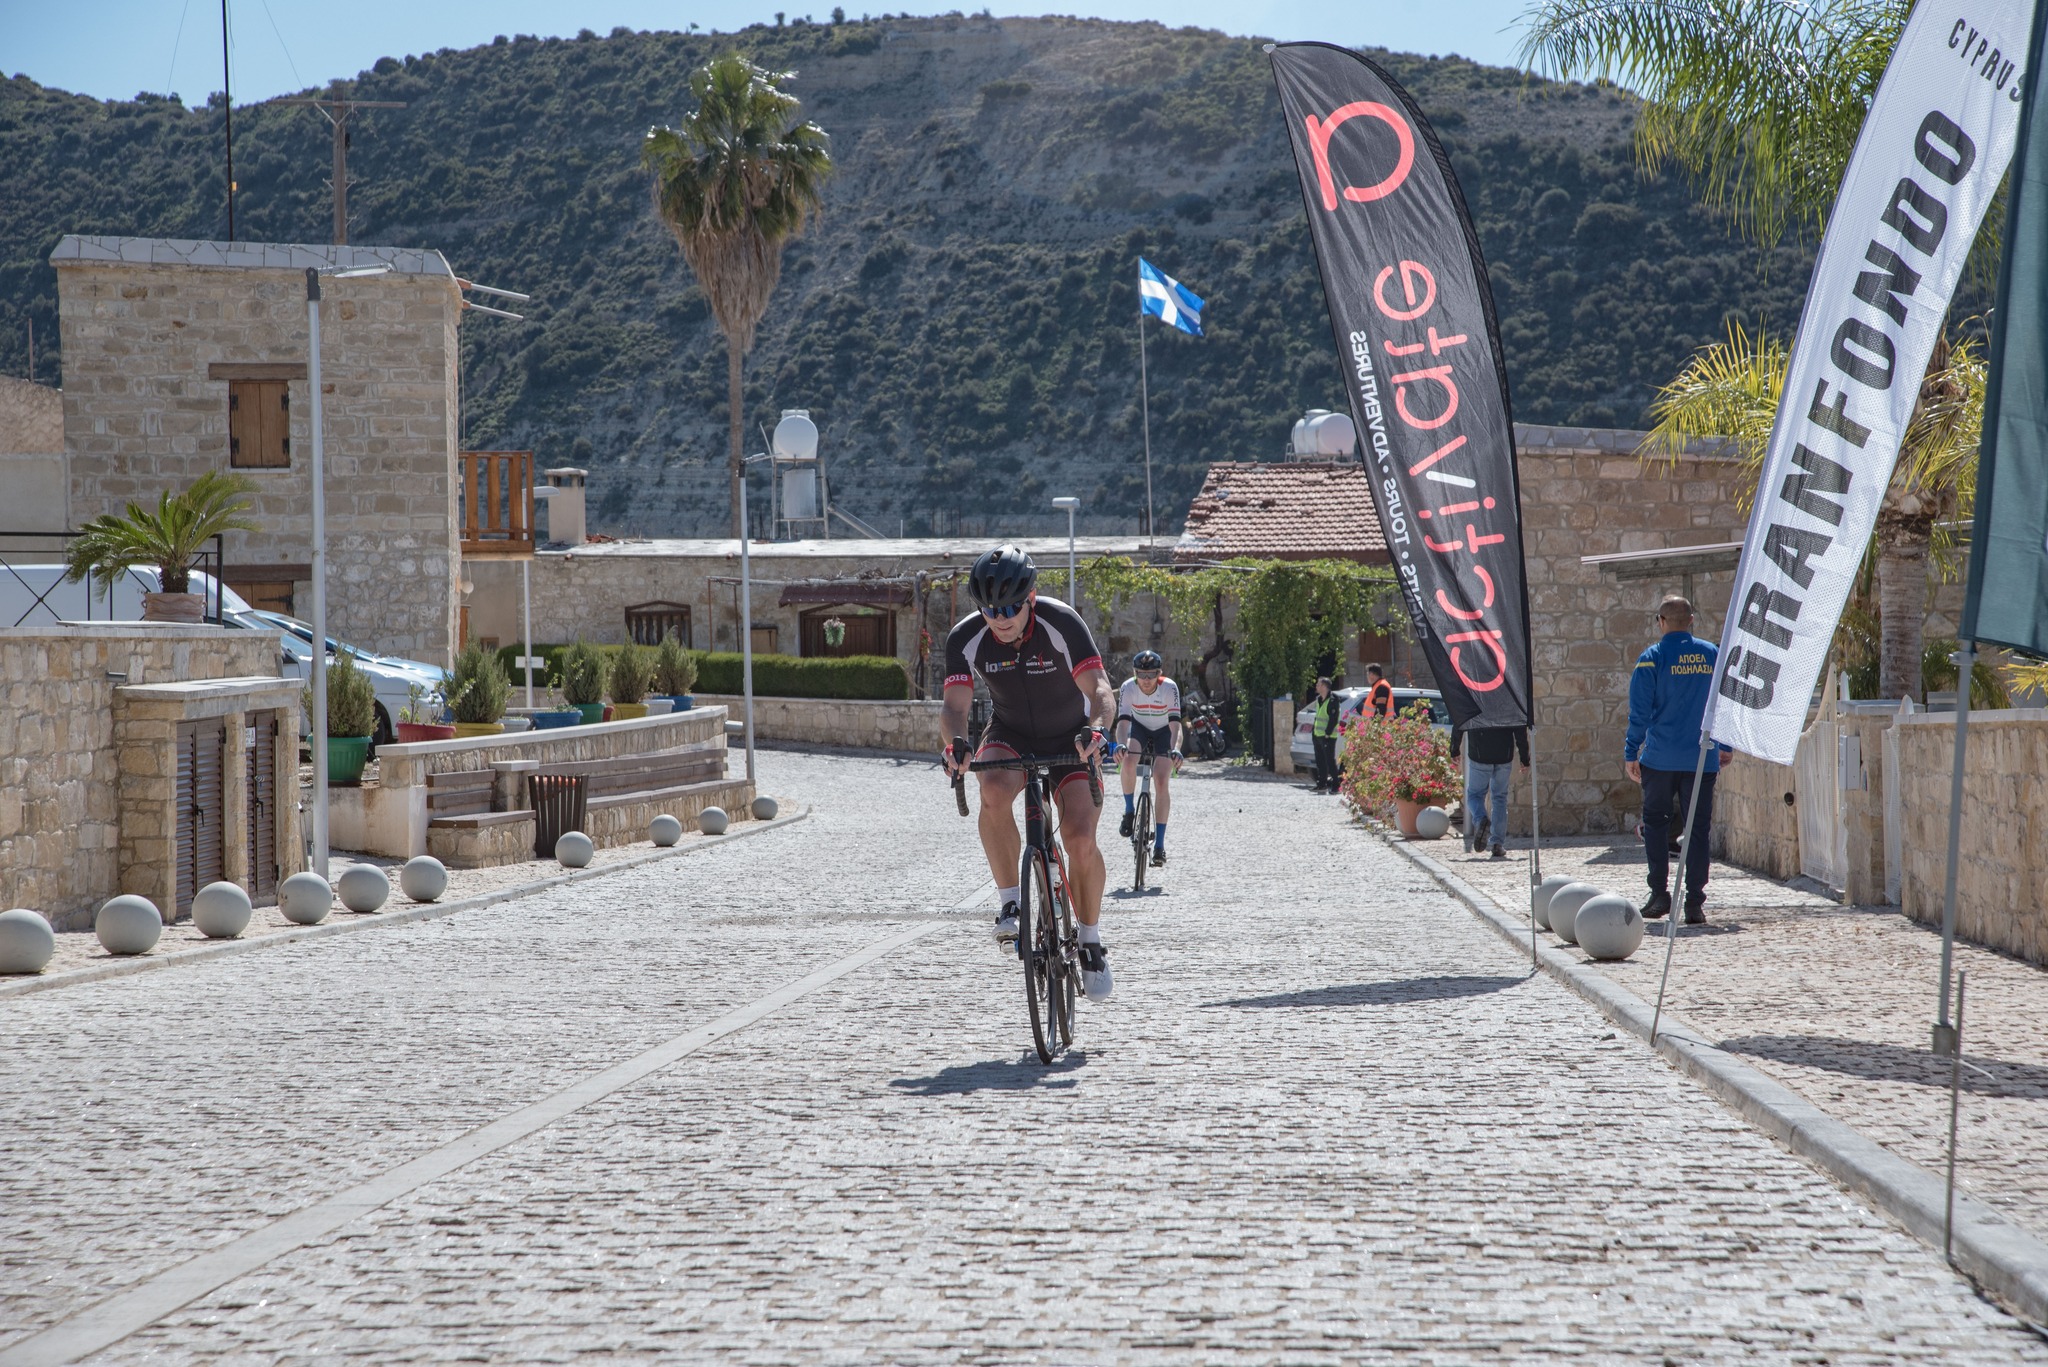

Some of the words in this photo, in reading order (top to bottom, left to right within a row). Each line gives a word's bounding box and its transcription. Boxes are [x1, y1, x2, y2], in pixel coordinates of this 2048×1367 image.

[1719, 110, 1976, 710] GRANFONDO
[1678, 653, 1707, 664] ΑΠΟΕΛ
[1671, 664, 1714, 675] ΠΟΔΗΛΑΣΙΑ
[944, 674, 969, 686] 2018
